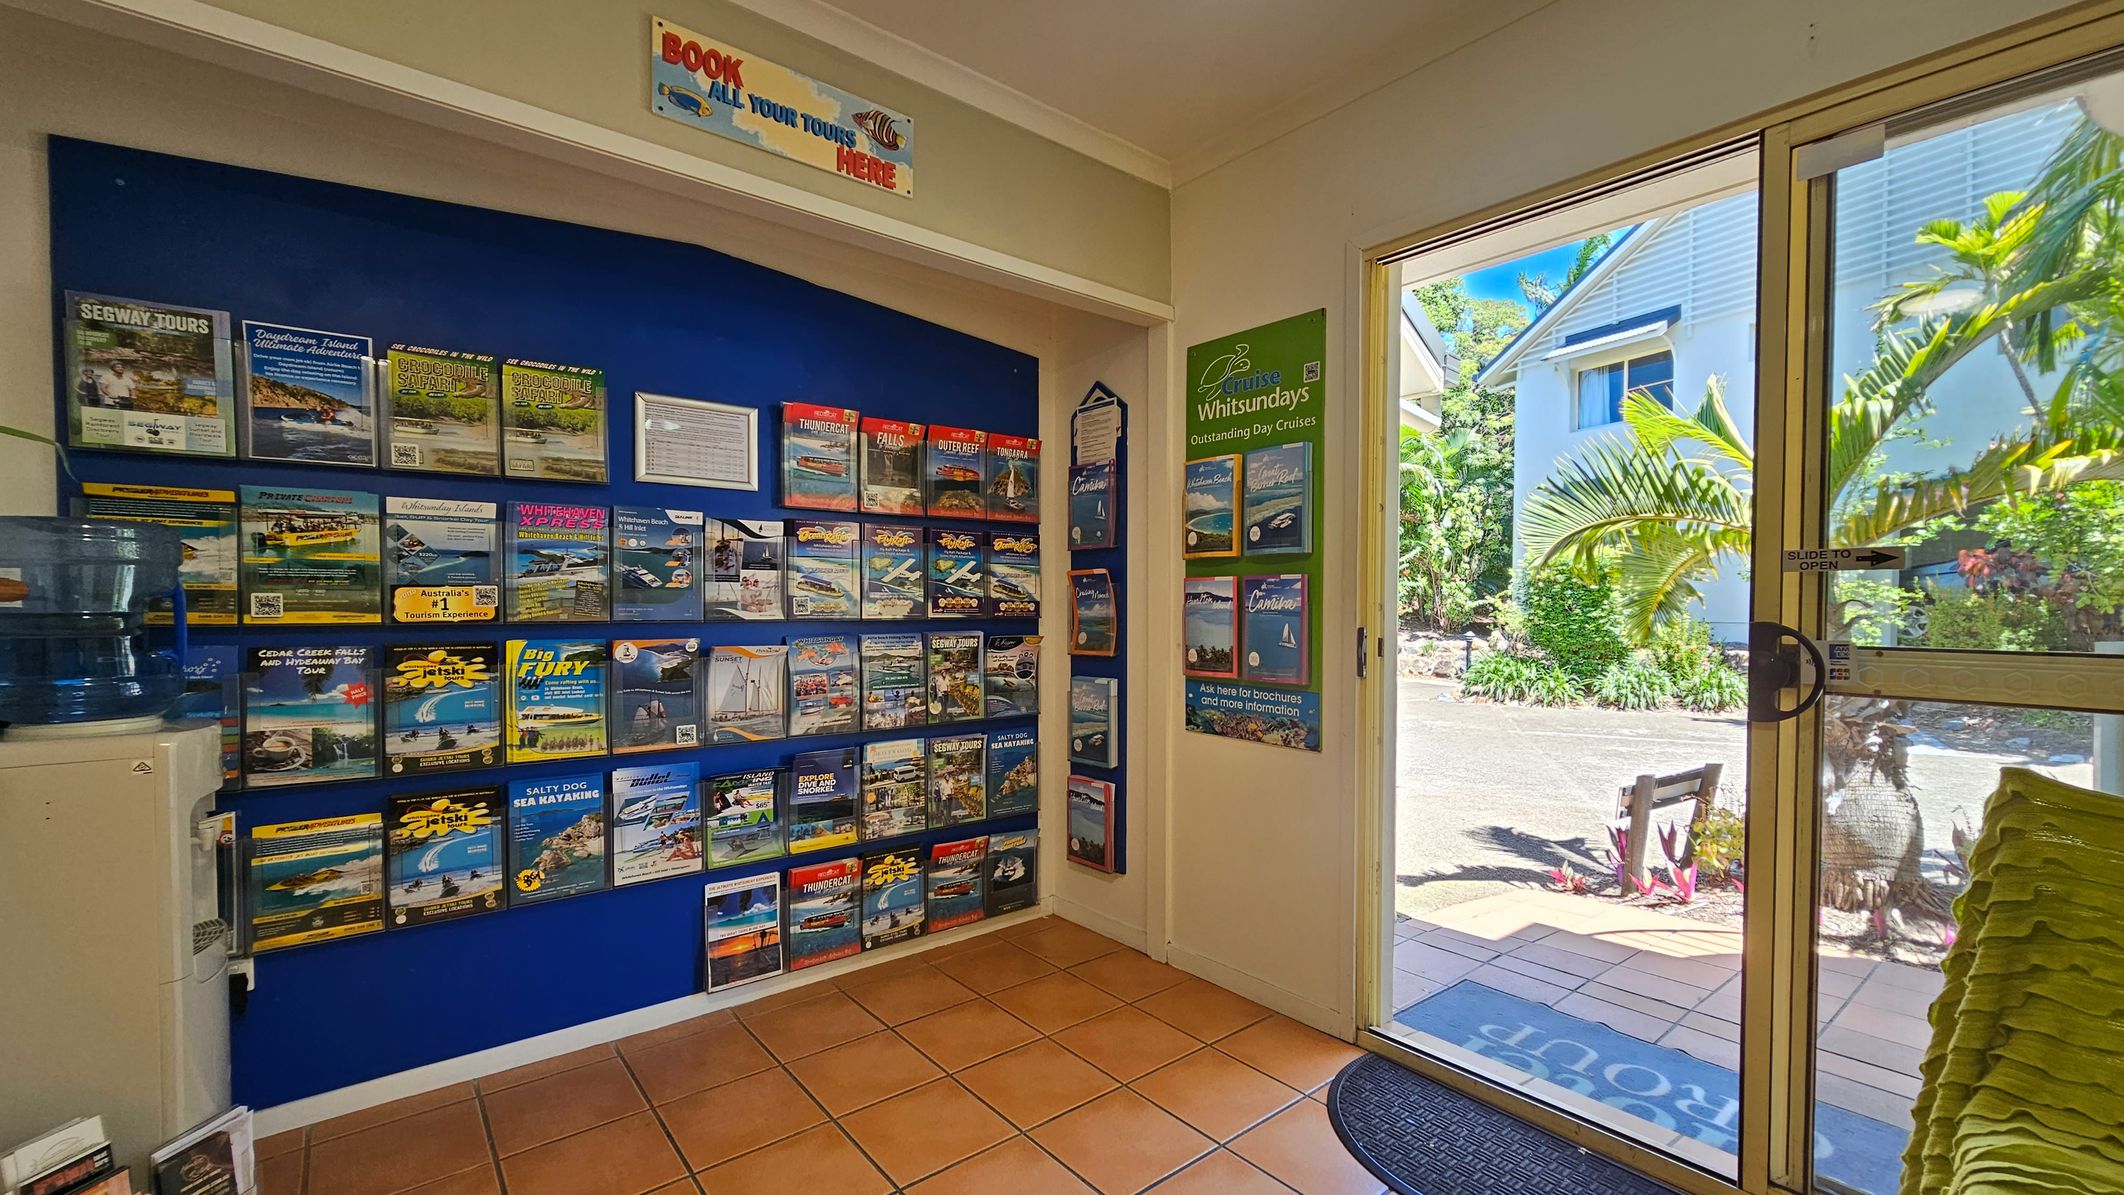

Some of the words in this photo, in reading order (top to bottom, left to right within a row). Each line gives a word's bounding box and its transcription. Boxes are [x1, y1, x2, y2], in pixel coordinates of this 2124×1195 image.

[662, 31, 744, 88] BOOK
[708, 81, 745, 109] ALL
[748, 93, 798, 128] YOUR
[800, 113, 857, 148] TOURS
[836, 145, 896, 190] HERE
[80, 304, 152, 327] SEGWAY
[154, 313, 209, 334] TOURS
[256, 329, 318, 345] Daydream
[321, 338, 358, 350] Island
[253, 339, 305, 353] Ultimate
[306, 346, 362, 360] Adventure
[391, 343, 404, 351] SEE
[407, 345, 448, 356] CROCODILES
[461, 352, 474, 360] THE
[476, 354, 494, 362] WILD
[398, 357, 488, 382] CROCODILE
[522, 360, 557, 371] CROCODILES
[581, 367, 597, 376] WILD
[398, 373, 457, 393] SAFARI
[511, 371, 592, 394] CROCODILE
[1220, 368, 1281, 396] Cruise
[511, 386, 564, 405] SAFARI
[1198, 386, 1310, 421] Whitsundays
[799, 418, 849, 434] THUNDERCAT
[1191, 427, 1250, 445] Outstanding
[1253, 423, 1273, 436] Day
[1276, 416, 1316, 430] Cruises
[877, 432, 905, 447] FALLS
[938, 440, 961, 452] OUTER
[962, 442, 980, 454] REEF
[997, 447, 1028, 459] TONGARRA
[258, 491, 303, 502] PRIVATE
[401, 500, 451, 514] Whitsunday
[454, 503, 483, 513] Islands
[519, 504, 605, 519] WHITEHAVEN
[519, 516, 604, 529] XPRESS
[618, 516, 650, 524] Whitehaven
[1787, 550, 1827, 560] SLIDE
[1832, 549, 1851, 559] TO
[1800, 561, 1838, 570] OPEN
[420, 588, 470, 598] Australia's
[431, 597, 450, 611] #1
[442, 611, 489, 620] Experience
[931, 639, 958, 648] SEGWAY
[958, 638, 978, 648] TOURS
[258, 649, 294, 657] CEDAR
[297, 648, 332, 656] CREEK
[335, 648, 366, 656] FALLS
[260, 659, 282, 667] AND
[285, 657, 341, 666] HYDEAWAY
[343, 656, 364, 665] BAY
[518, 660, 590, 677] FURY
[296, 666, 326, 675] TOUR
[422, 665, 465, 679] jetski
[1200, 683, 1215, 694] Ask
[1217, 685, 1237, 697] here
[1239, 688, 1251, 698] for
[1253, 689, 1302, 705] brochures
[1201, 697, 1218, 706] and
[1220, 701, 1243, 710] more
[1245, 699, 1300, 717] information
[933, 742, 960, 753] SEGWAY
[961, 740, 982, 750] TOURS
[1003, 739, 1034, 748] KAYAKING
[743, 771, 774, 779] ISLAND
[798, 773, 835, 782] EXPLORE
[526, 785, 559, 795] SALTY
[563, 781, 587, 791] DOG
[797, 786, 835, 795] SNORKEL
[798, 780, 817, 788] DIVE
[819, 779, 836, 787] AND
[513, 798, 536, 808] SEA
[538, 790, 600, 804] KAYAKING
[425, 812, 468, 828] jetski
[938, 849, 978, 865] THUNDERCAT
[881, 865, 905, 877] jetski
[803, 875, 852, 893] THUNDERCAT
